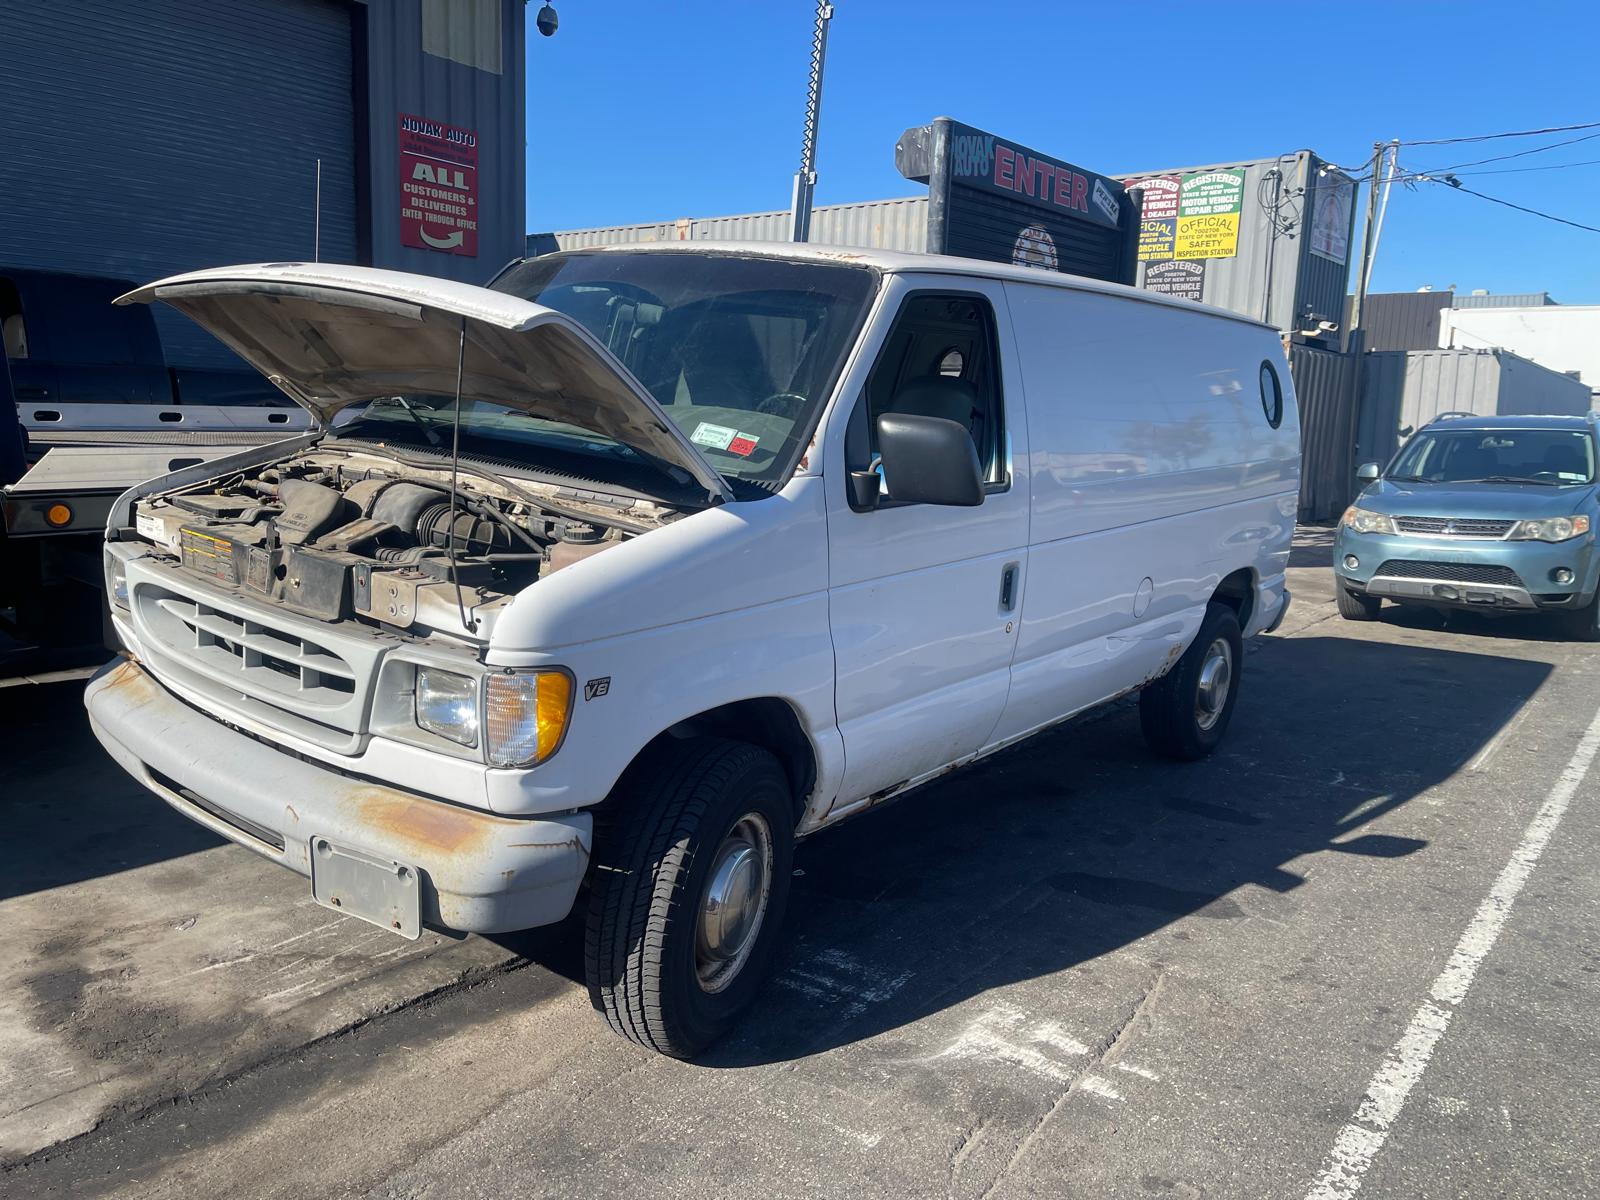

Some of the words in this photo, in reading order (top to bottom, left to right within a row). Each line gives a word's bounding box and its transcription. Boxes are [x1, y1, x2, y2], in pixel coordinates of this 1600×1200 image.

[402, 117, 443, 139] NOVAK
[446, 129, 476, 147] AUTO
[954, 155, 990, 176] AUTO
[412, 163, 470, 190] ALL
[994, 144, 1089, 213] ENTER
[1182, 173, 1242, 191] REGISTERED
[403, 182, 466, 204] CUSTOMERS
[468, 197, 475, 205] &
[1125, 180, 1179, 193] GISTERED
[411, 197, 467, 216] DELIVERIES
[1148, 200, 1177, 209] VEHICLE
[1182, 197, 1208, 207] MOTOR
[1209, 195, 1239, 205] VEHICLE
[1147, 210, 1176, 218] DEALER
[1185, 205, 1212, 215] REPAIR
[1213, 204, 1234, 213] SHOP
[402, 208, 422, 220] ENTER
[425, 212, 455, 226] THROUGH
[456, 218, 477, 230] OFFICE
[1180, 217, 1232, 233] OFFICIAL
[1141, 222, 1171, 235] FICIAL
[1138, 244, 1169, 253] ORCYCLE
[1189, 240, 1223, 248] SAFETY
[1176, 249, 1209, 258] INSPECTION
[1210, 248, 1233, 256] STATION
[1147, 261, 1204, 277] REGISTERED
[1146, 283, 1170, 291] MOTOR
[1172, 282, 1201, 291] VEHICLE
[585, 682, 608, 701] V8
